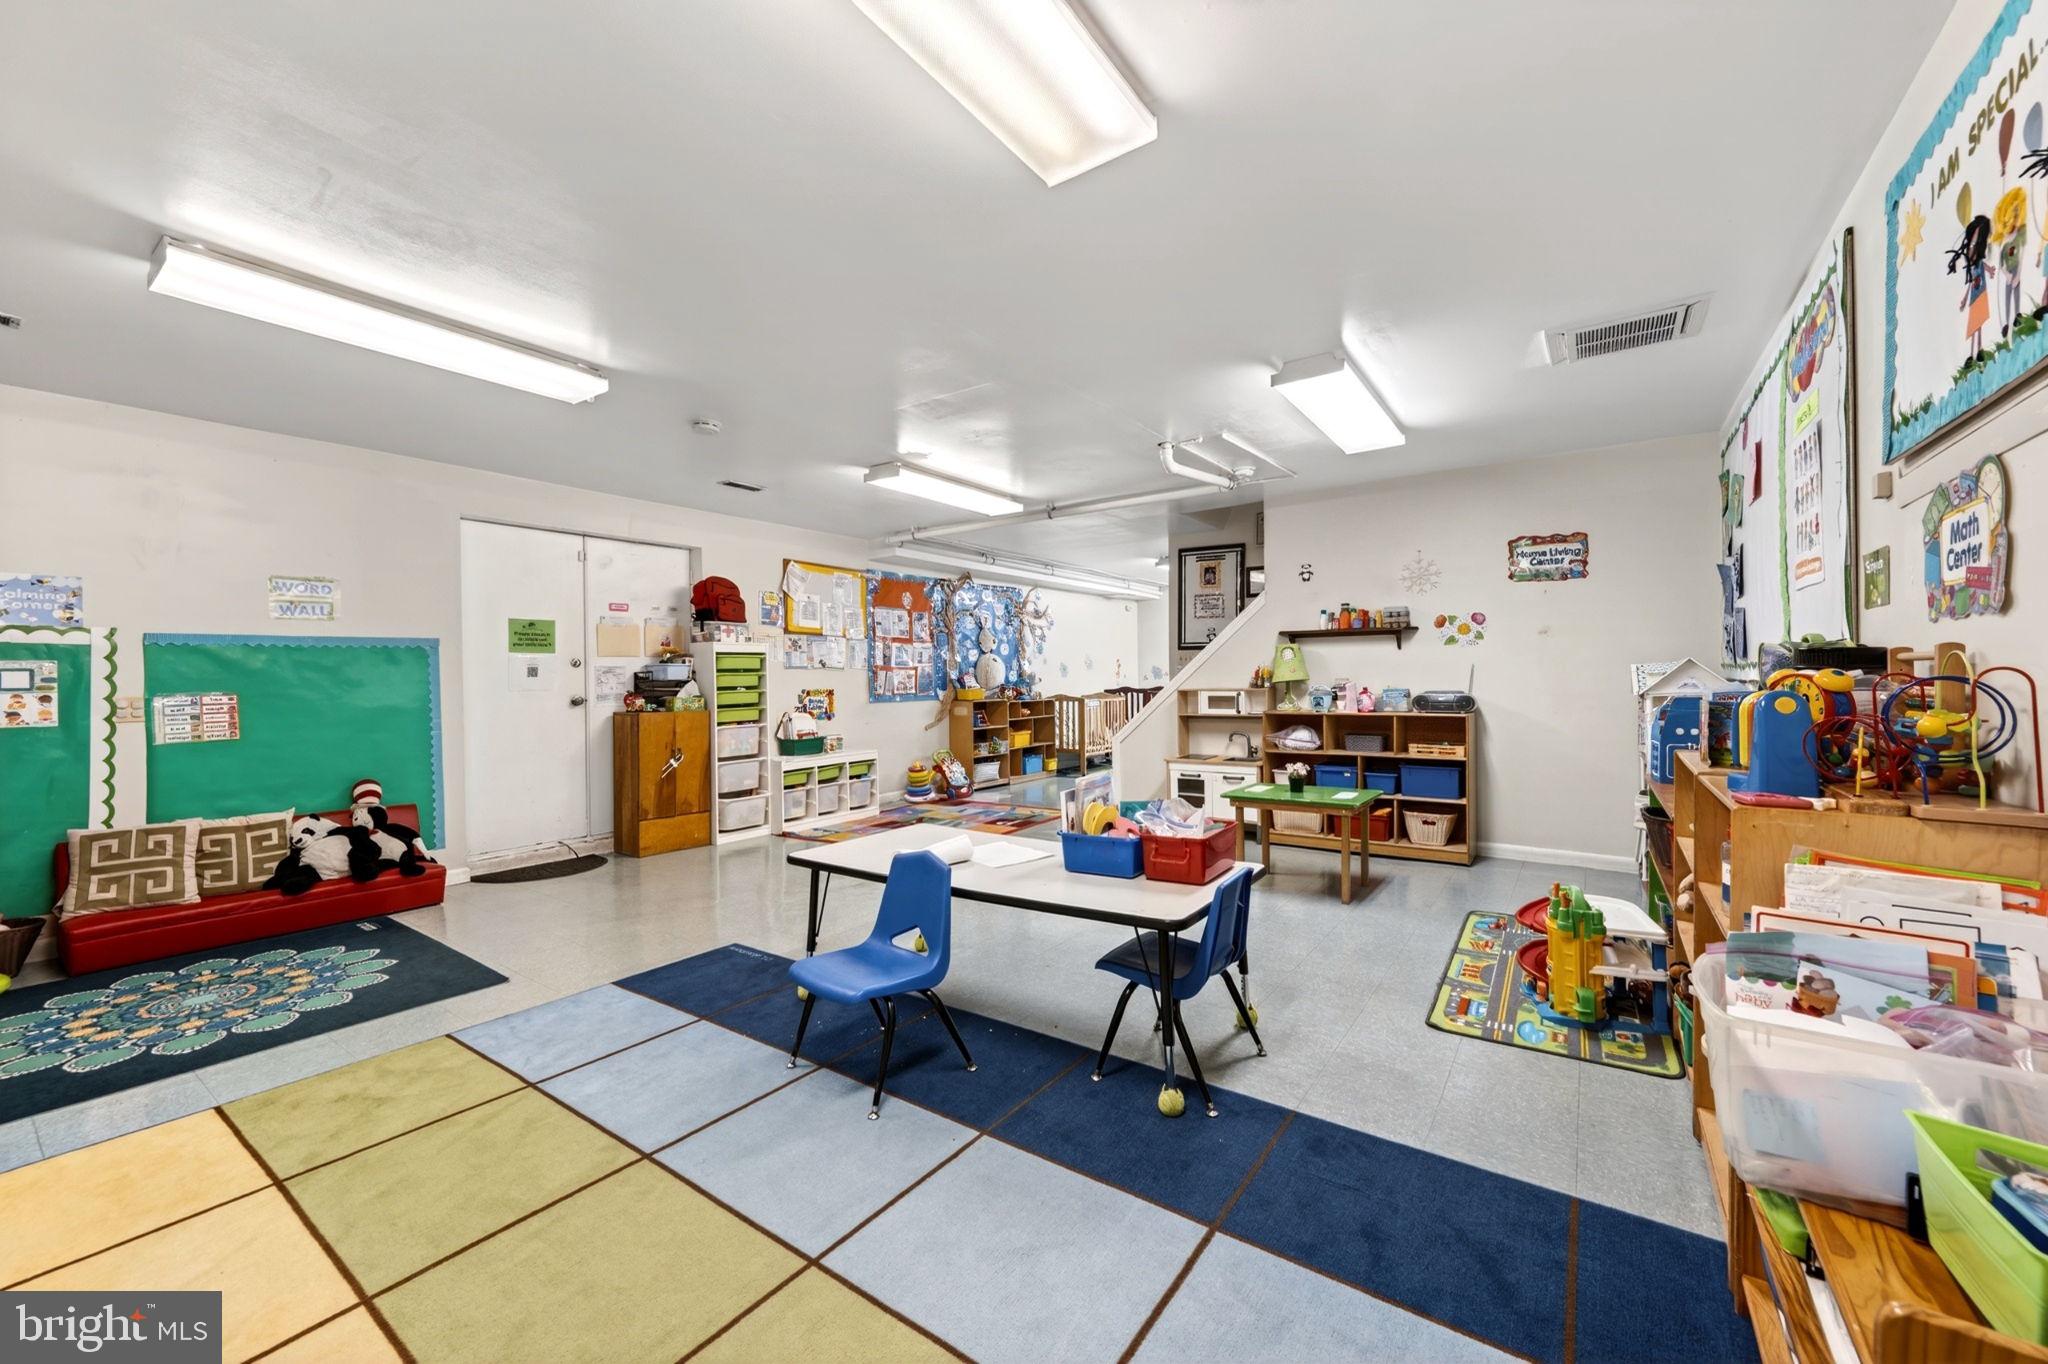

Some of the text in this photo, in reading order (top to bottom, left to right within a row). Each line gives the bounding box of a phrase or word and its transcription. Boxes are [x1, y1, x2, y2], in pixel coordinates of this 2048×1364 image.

[1930, 183, 1936, 209] I
[1937, 146, 1960, 199] AM
[1950, 511, 1980, 545] Math
[1549, 547, 1582, 557] Living
[1946, 542, 1983, 572] Center
[1529, 557, 1566, 566] Center
[0, 588, 67, 602] alming
[273, 581, 333, 595] WORD
[278, 604, 329, 617] WALL
